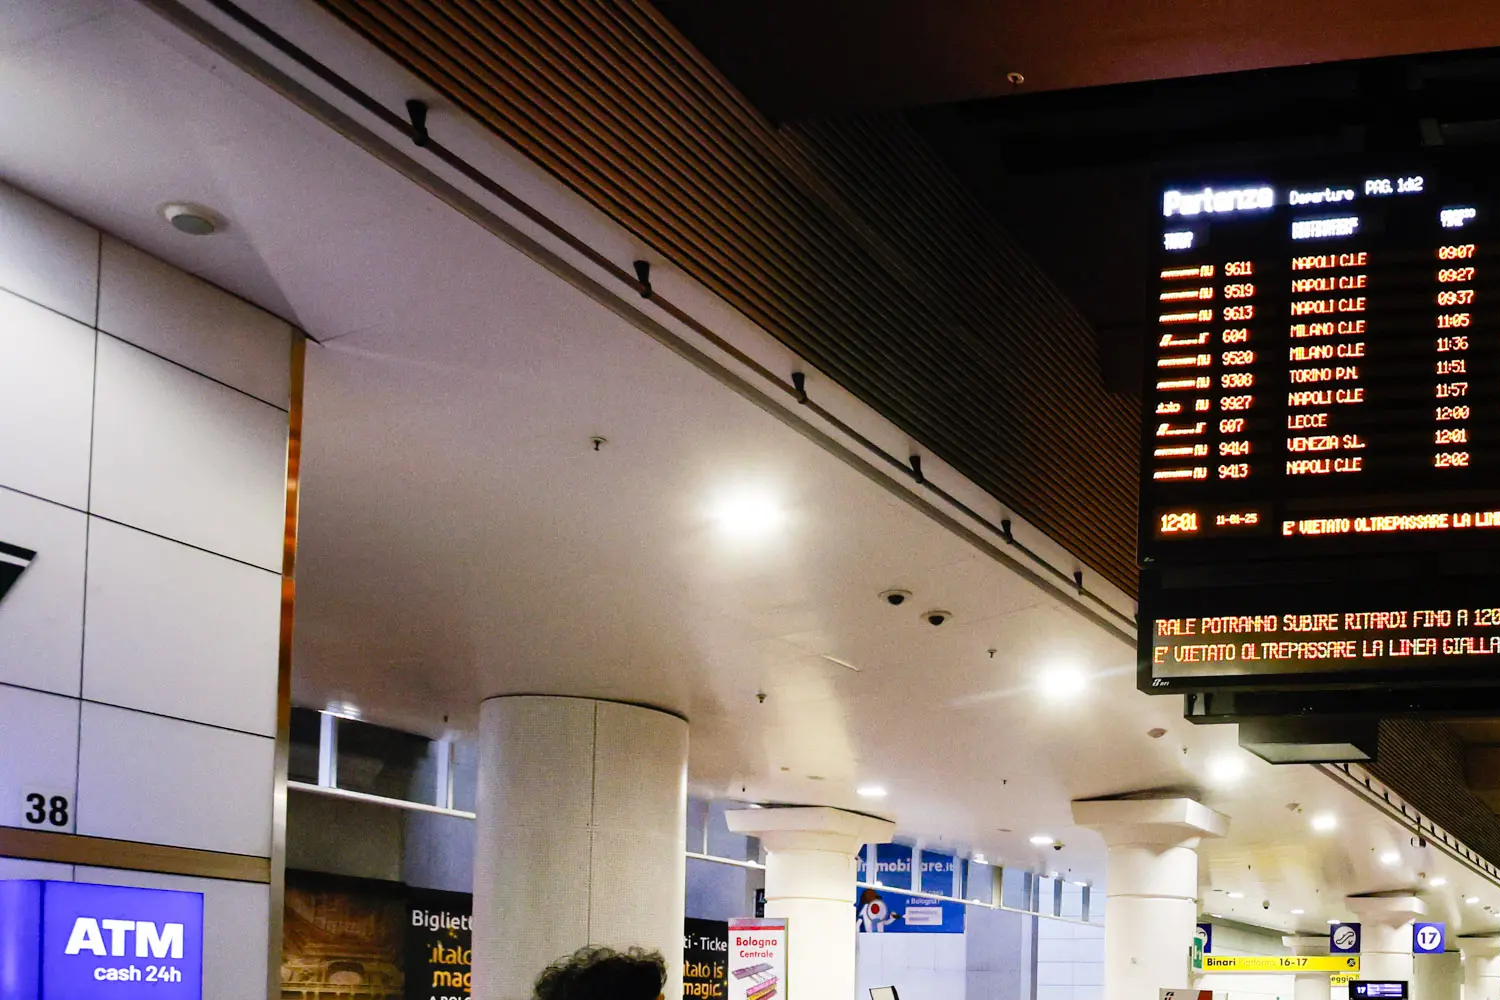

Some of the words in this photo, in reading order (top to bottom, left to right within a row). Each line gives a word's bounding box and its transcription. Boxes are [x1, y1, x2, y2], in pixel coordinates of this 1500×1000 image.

[1225, 261, 1252, 276] 9611
[1292, 255, 1338, 270] NAPOLI
[1439, 245, 1475, 259] 09:07
[1222, 373, 1253, 388] 9308
[1290, 368, 1334, 383] TORINO
[1437, 360, 1466, 374] 11:51
[1220, 419, 1244, 433] 607
[1288, 414, 1327, 429] LECCE
[1436, 406, 1469, 420] 12:00
[1161, 513, 1199, 534] 12:01
[1156, 618, 1196, 636] RALE
[1202, 616, 1277, 634] POTRANNO
[1283, 614, 1338, 632] SUBIRE
[1345, 611, 1407, 630] RITARDI
[1414, 610, 1451, 627] FINO
[1458, 610, 1468, 626] A
[1174, 643, 1235, 663] VIETATO
[1241, 641, 1356, 661] OLTREPASSARE
[1363, 640, 1383, 657] LA
[1390, 638, 1437, 656] LINEA
[1443, 637, 1500, 654] GIALLA
[26, 793, 69, 826] 38
[64, 917, 184, 959] ATM
[736, 936, 778, 948] Bologna
[1420, 932, 1438, 944] 17
[740, 950, 774, 958] Centrale
[1207, 958, 1236, 966] Binari
[1280, 958, 1308, 966] 16-17
[94, 965, 141, 981] cash
[145, 966, 182, 982] 24h
